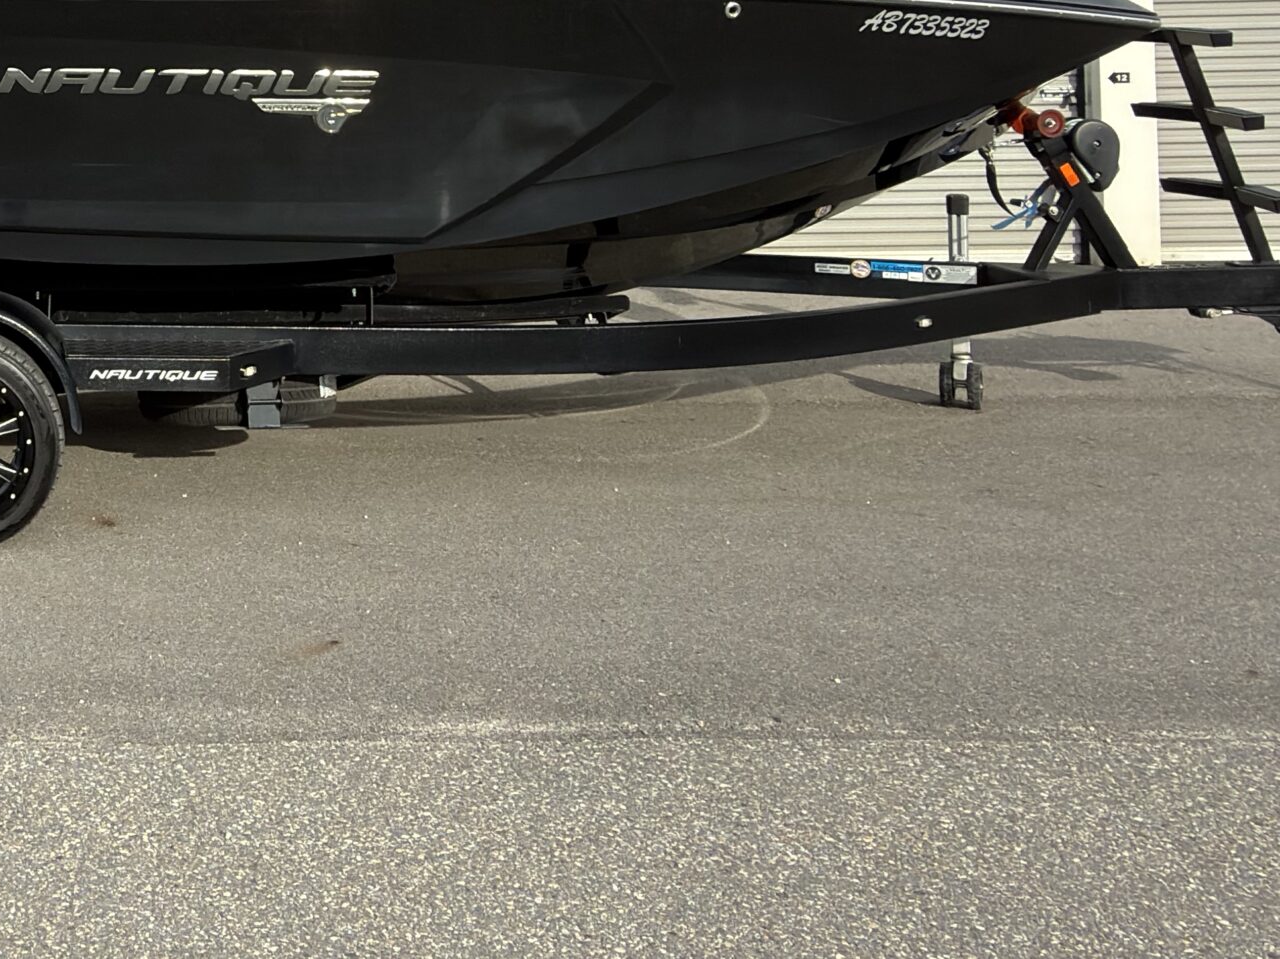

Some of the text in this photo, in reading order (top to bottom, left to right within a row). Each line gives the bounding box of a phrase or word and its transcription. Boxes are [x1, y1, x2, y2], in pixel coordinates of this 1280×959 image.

[858, 9, 990, 39] AB7335323
[1115, 74, 1128, 82] 12
[89, 369, 219, 382] NAUTIQUE
